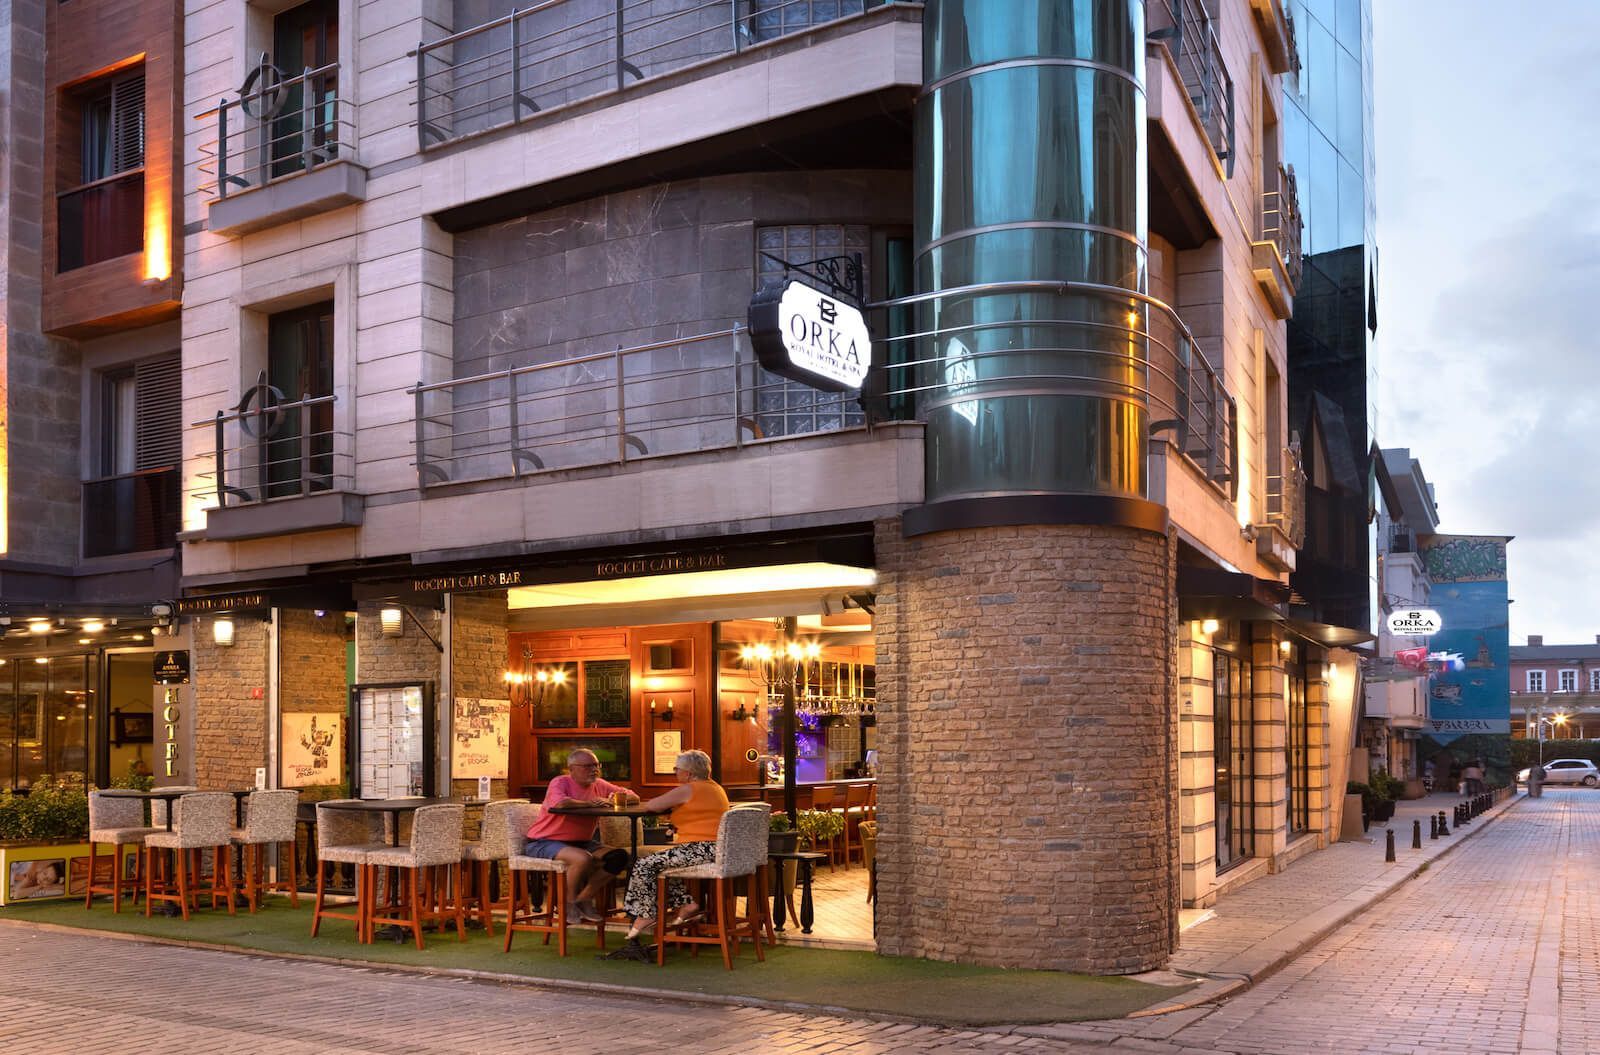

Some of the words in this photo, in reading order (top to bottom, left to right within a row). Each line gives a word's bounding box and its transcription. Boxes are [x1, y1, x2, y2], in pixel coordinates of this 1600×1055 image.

[791, 313, 861, 365] ORKA
[596, 559, 646, 576] ROCKET
[686, 555, 694, 568] &
[699, 553, 726, 567] BAR
[414, 577, 455, 591] ROCKET
[488, 574, 496, 585] &
[499, 571, 521, 585] BAR
[164, 687, 180, 777] HOTEL
[1445, 719, 1492, 730] BARBERA
